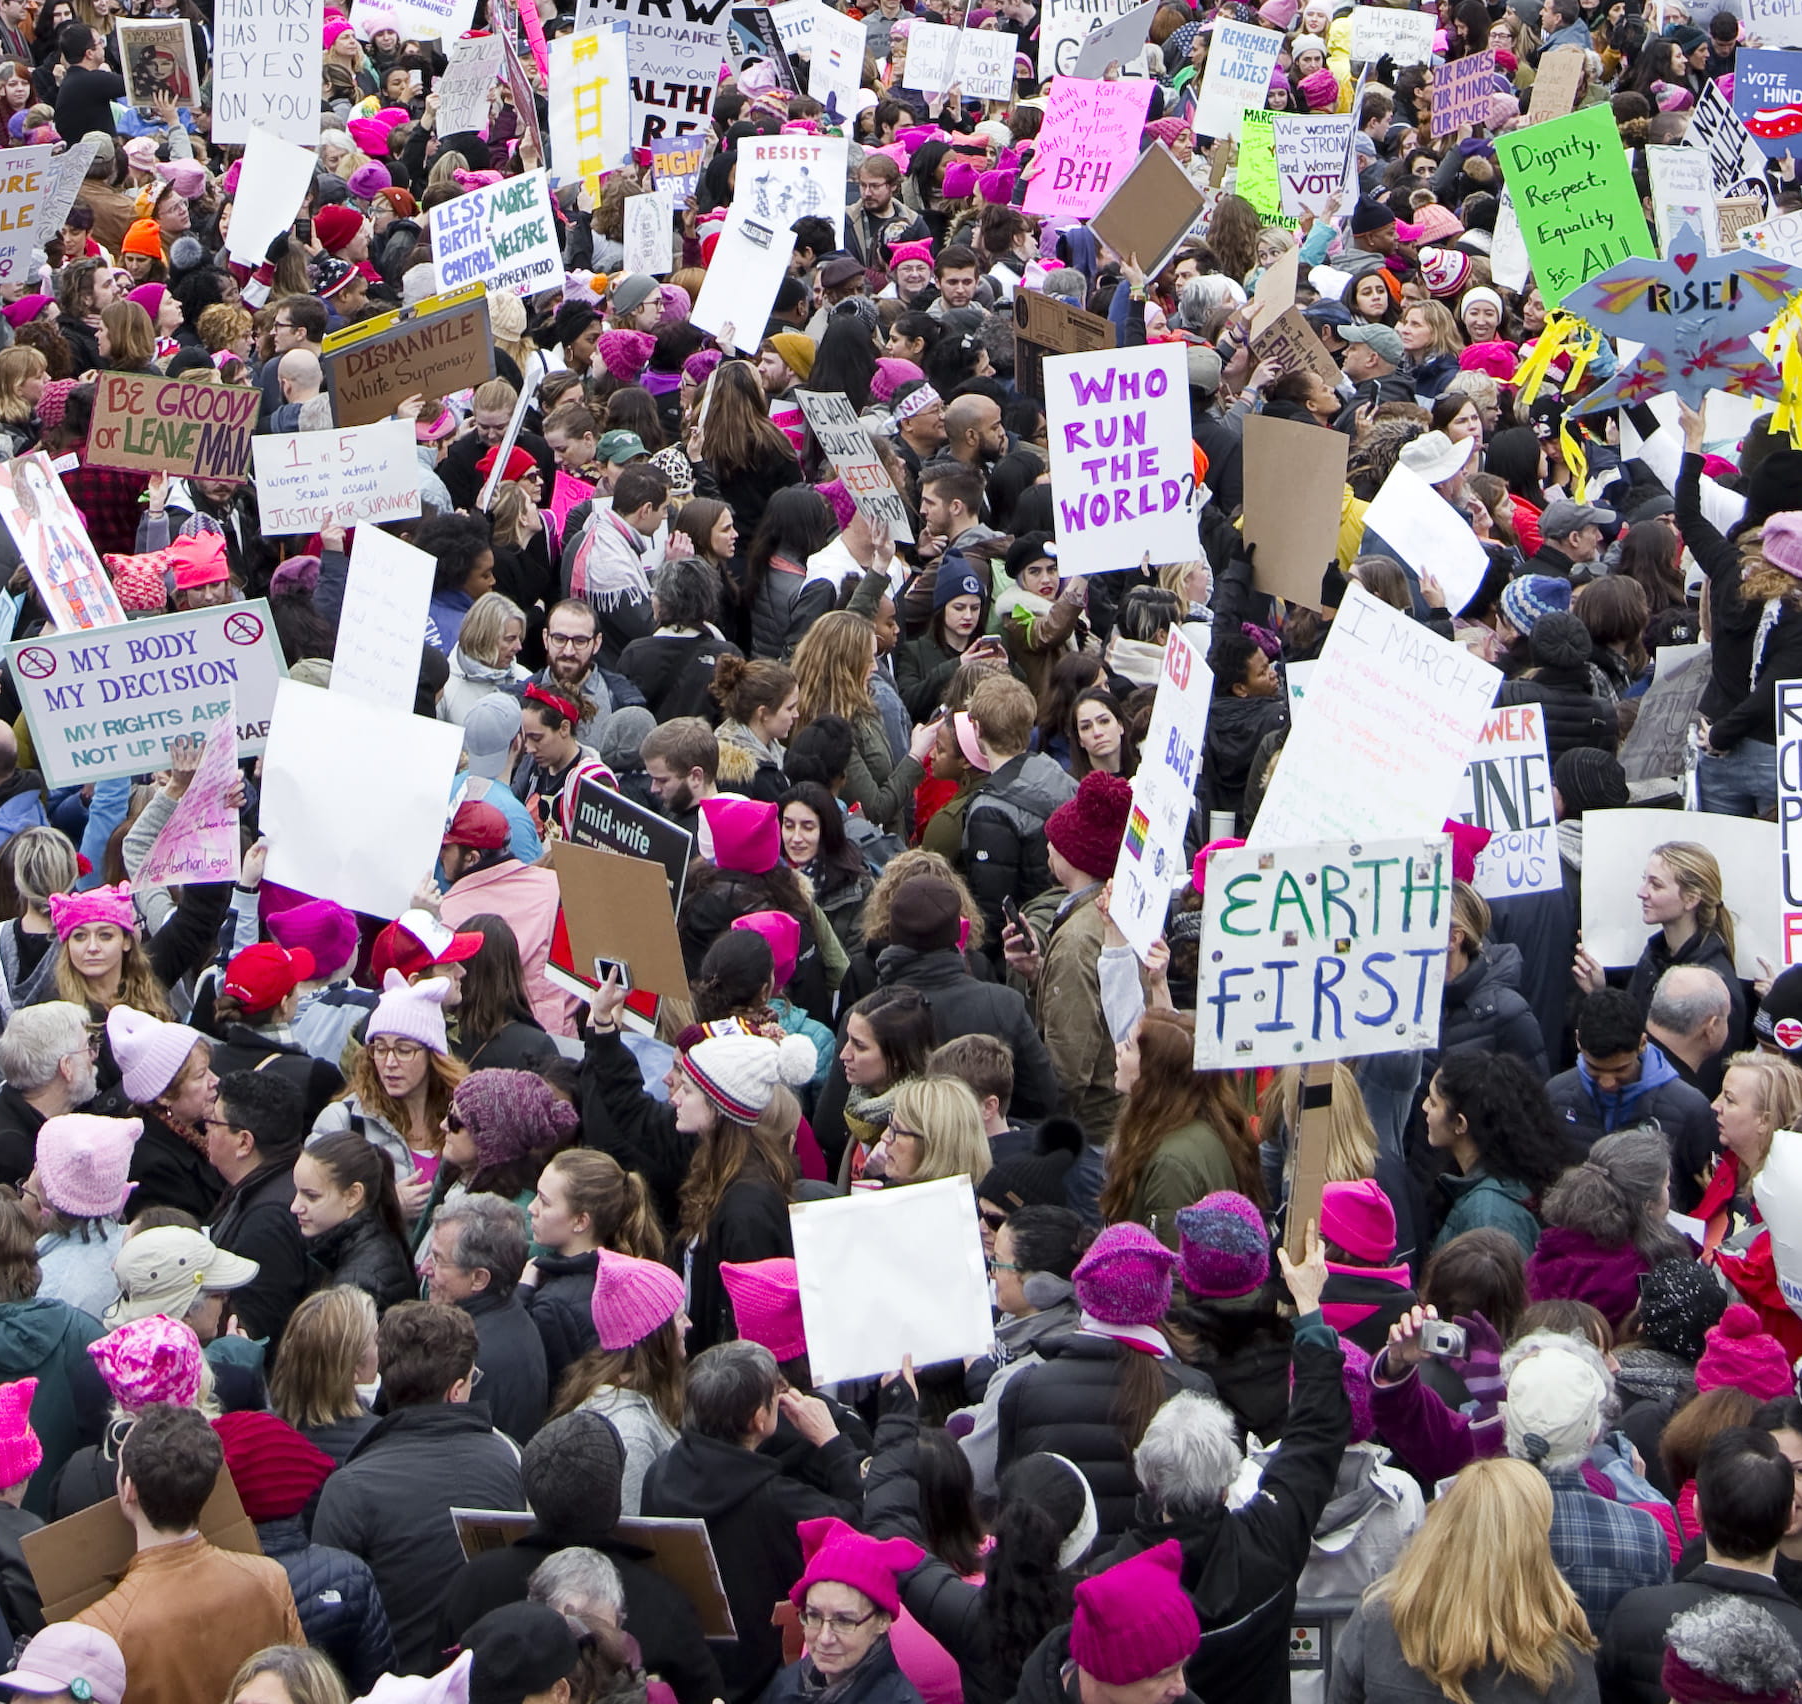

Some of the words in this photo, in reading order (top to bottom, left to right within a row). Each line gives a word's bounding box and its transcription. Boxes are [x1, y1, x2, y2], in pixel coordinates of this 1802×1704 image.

[222, 23, 257, 47] HAS
[279, 23, 310, 43] ITS
[1220, 27, 1279, 55] REMEMBER
[220, 52, 304, 80] EYES
[1220, 61, 1268, 84] LADIES
[1237, 49, 1254, 64] THE
[1746, 72, 1788, 86] VOTE
[219, 92, 246, 122] ON
[262, 92, 311, 120] YOU
[6, 158, 36, 171] THE
[1537, 209, 1613, 245] Equality
[1547, 268, 1575, 285] for
[345, 313, 476, 378] DISMANTLE
[340, 370, 394, 404] White
[394, 349, 477, 386] Supremacy
[1069, 368, 1168, 407] WHO
[108, 380, 145, 415] BE
[156, 382, 257, 431] GROOVY
[95, 428, 121, 449] or
[1063, 411, 1146, 453] RUN
[1081, 446, 1160, 486] THE
[1060, 472, 1195, 533] WORLD?
[69, 645, 110, 674] MY
[126, 630, 198, 664] BODY
[43, 683, 85, 712] MY
[98, 658, 239, 704] DECISION
[1220, 852, 1450, 940] EARTH
[1207, 947, 1448, 1043] FIRST
